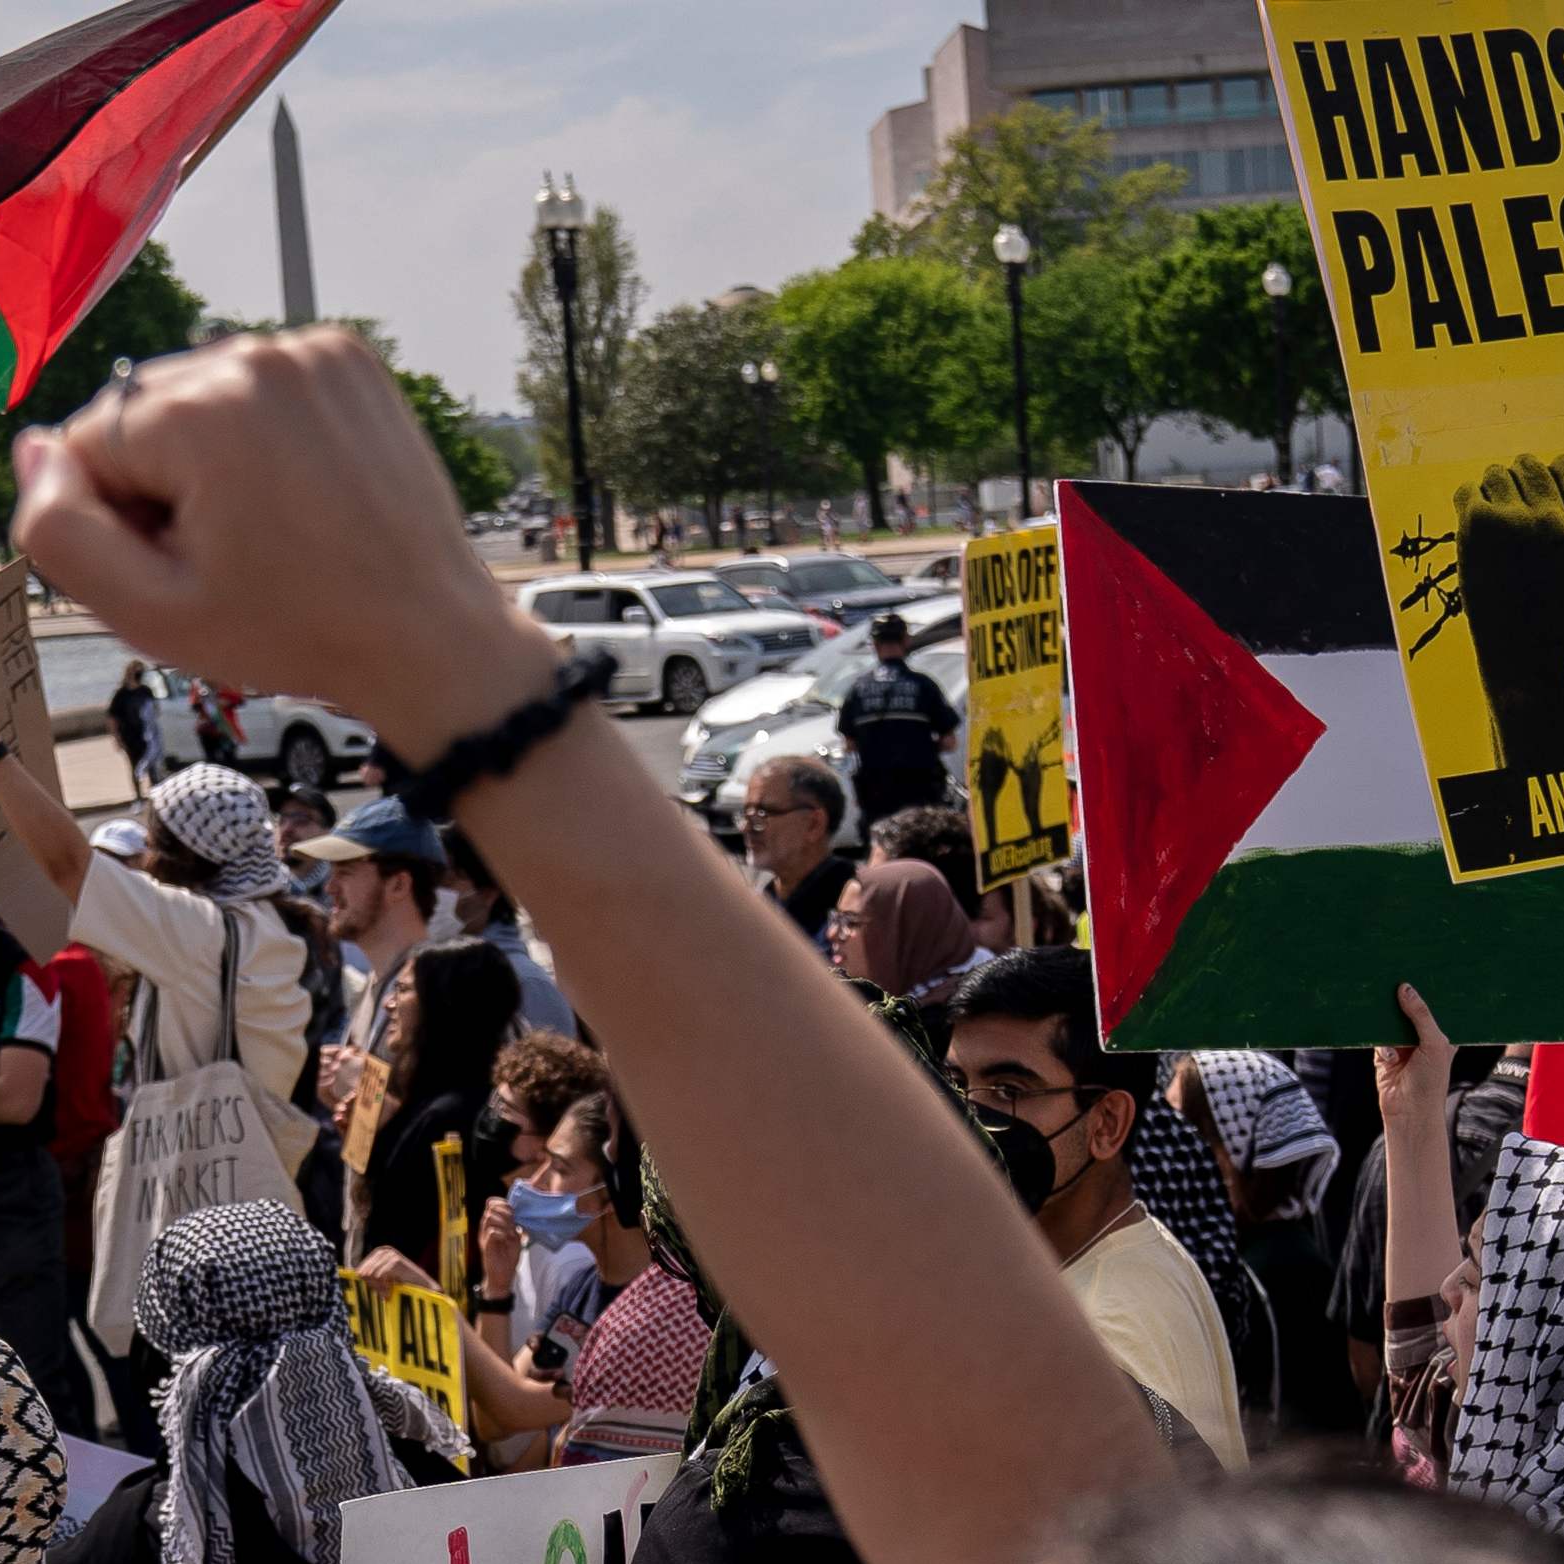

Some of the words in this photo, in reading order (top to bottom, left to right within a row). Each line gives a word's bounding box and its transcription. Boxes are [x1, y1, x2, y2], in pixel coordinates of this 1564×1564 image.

[967, 552, 1013, 615] HANDS
[1018, 545, 1055, 601] OFF
[970, 610, 1058, 682] PALESTINE!
[131, 1096, 244, 1167] FARMER'S
[137, 1155, 239, 1222] MARKET
[400, 1294, 450, 1377] ALL
